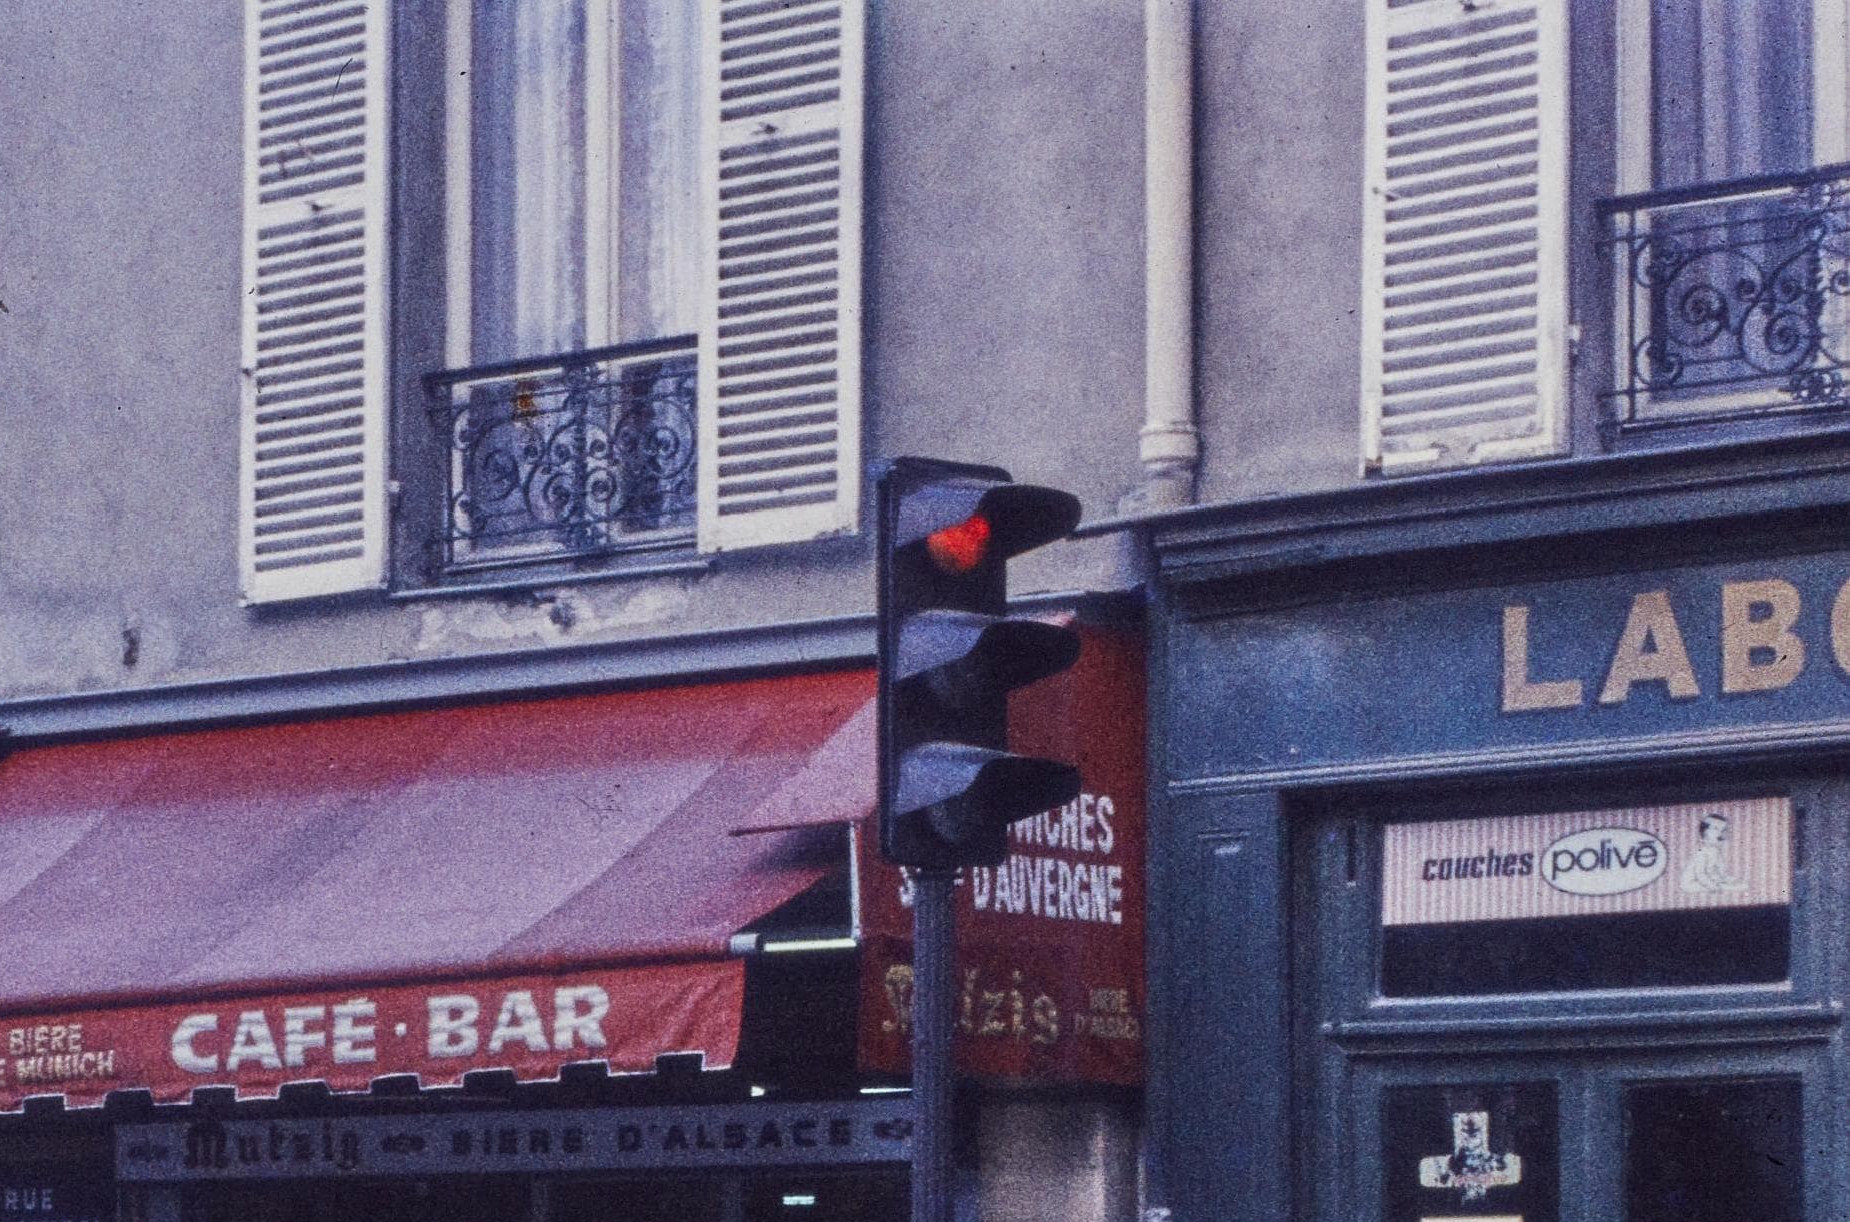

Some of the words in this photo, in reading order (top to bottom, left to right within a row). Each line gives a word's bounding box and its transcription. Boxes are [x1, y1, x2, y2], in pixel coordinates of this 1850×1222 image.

[1502, 578, 1850, 712] LAB
[972, 855, 1122, 925] DAUVERGNE
[1422, 849, 1534, 882] couches
[427, 985, 610, 1059] BAR
[16, 1049, 115, 1081] MUNICH
[5, 1188, 53, 1211] RUE
